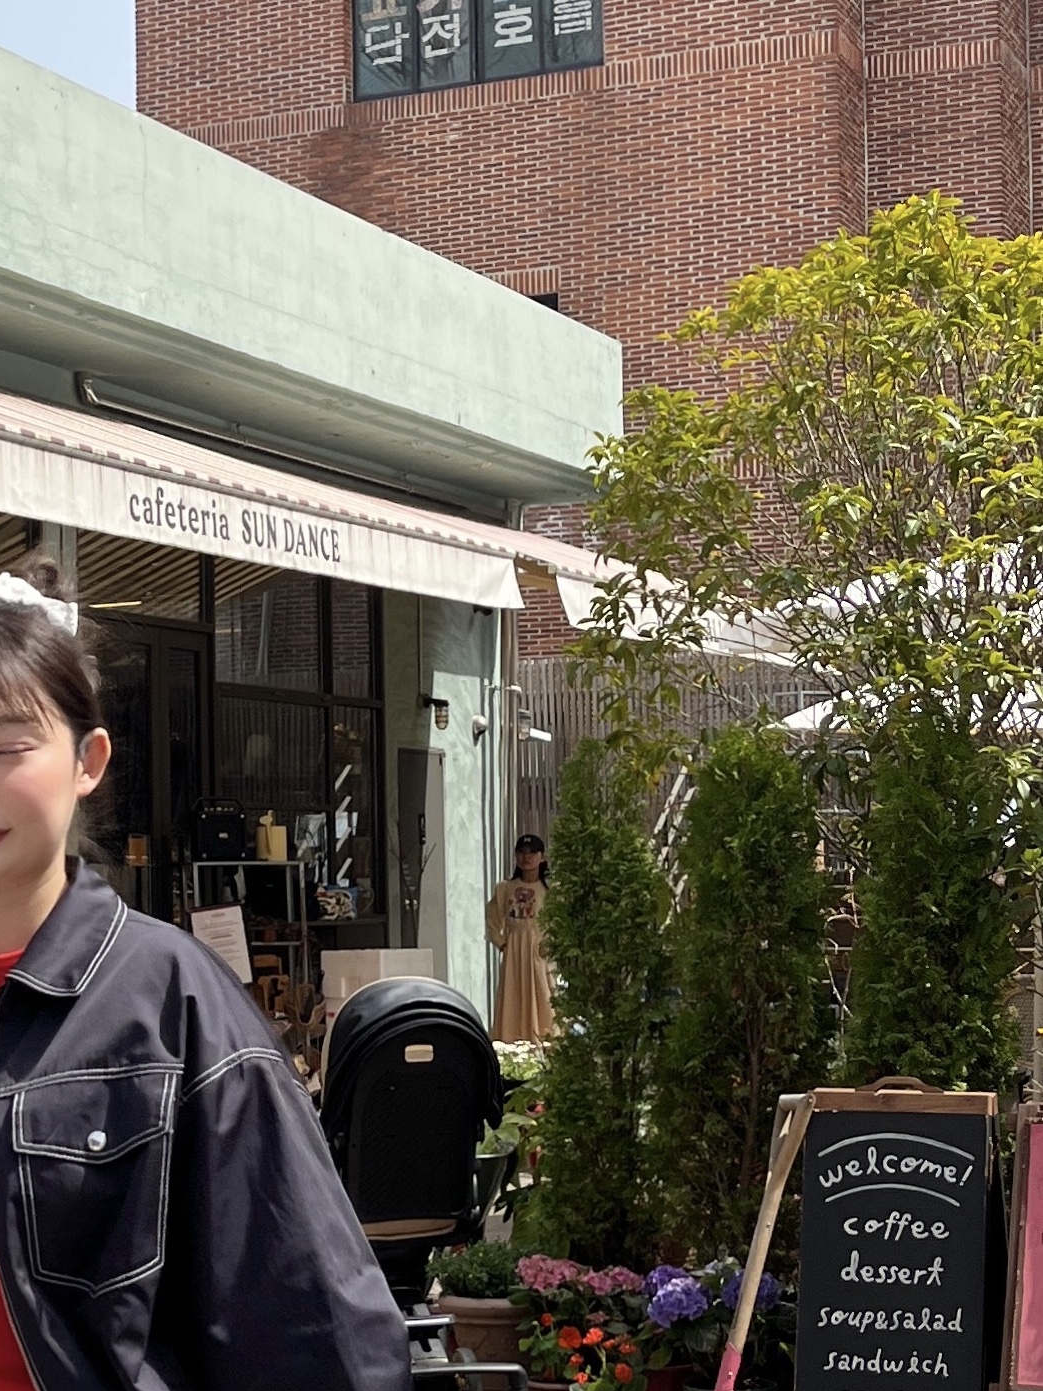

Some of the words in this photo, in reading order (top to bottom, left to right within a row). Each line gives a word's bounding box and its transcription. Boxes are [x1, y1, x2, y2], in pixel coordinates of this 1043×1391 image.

[130, 487, 230, 541] cafeteria
[242, 510, 277, 549] SUN
[284, 519, 341, 563] DANCE
[818, 1146, 973, 1188] welcome!
[843, 1211, 950, 1241] coffee
[840, 1250, 945, 1286] dessert
[817, 1307, 963, 1333] soup&salad
[823, 1349, 949, 1377] sandwich
